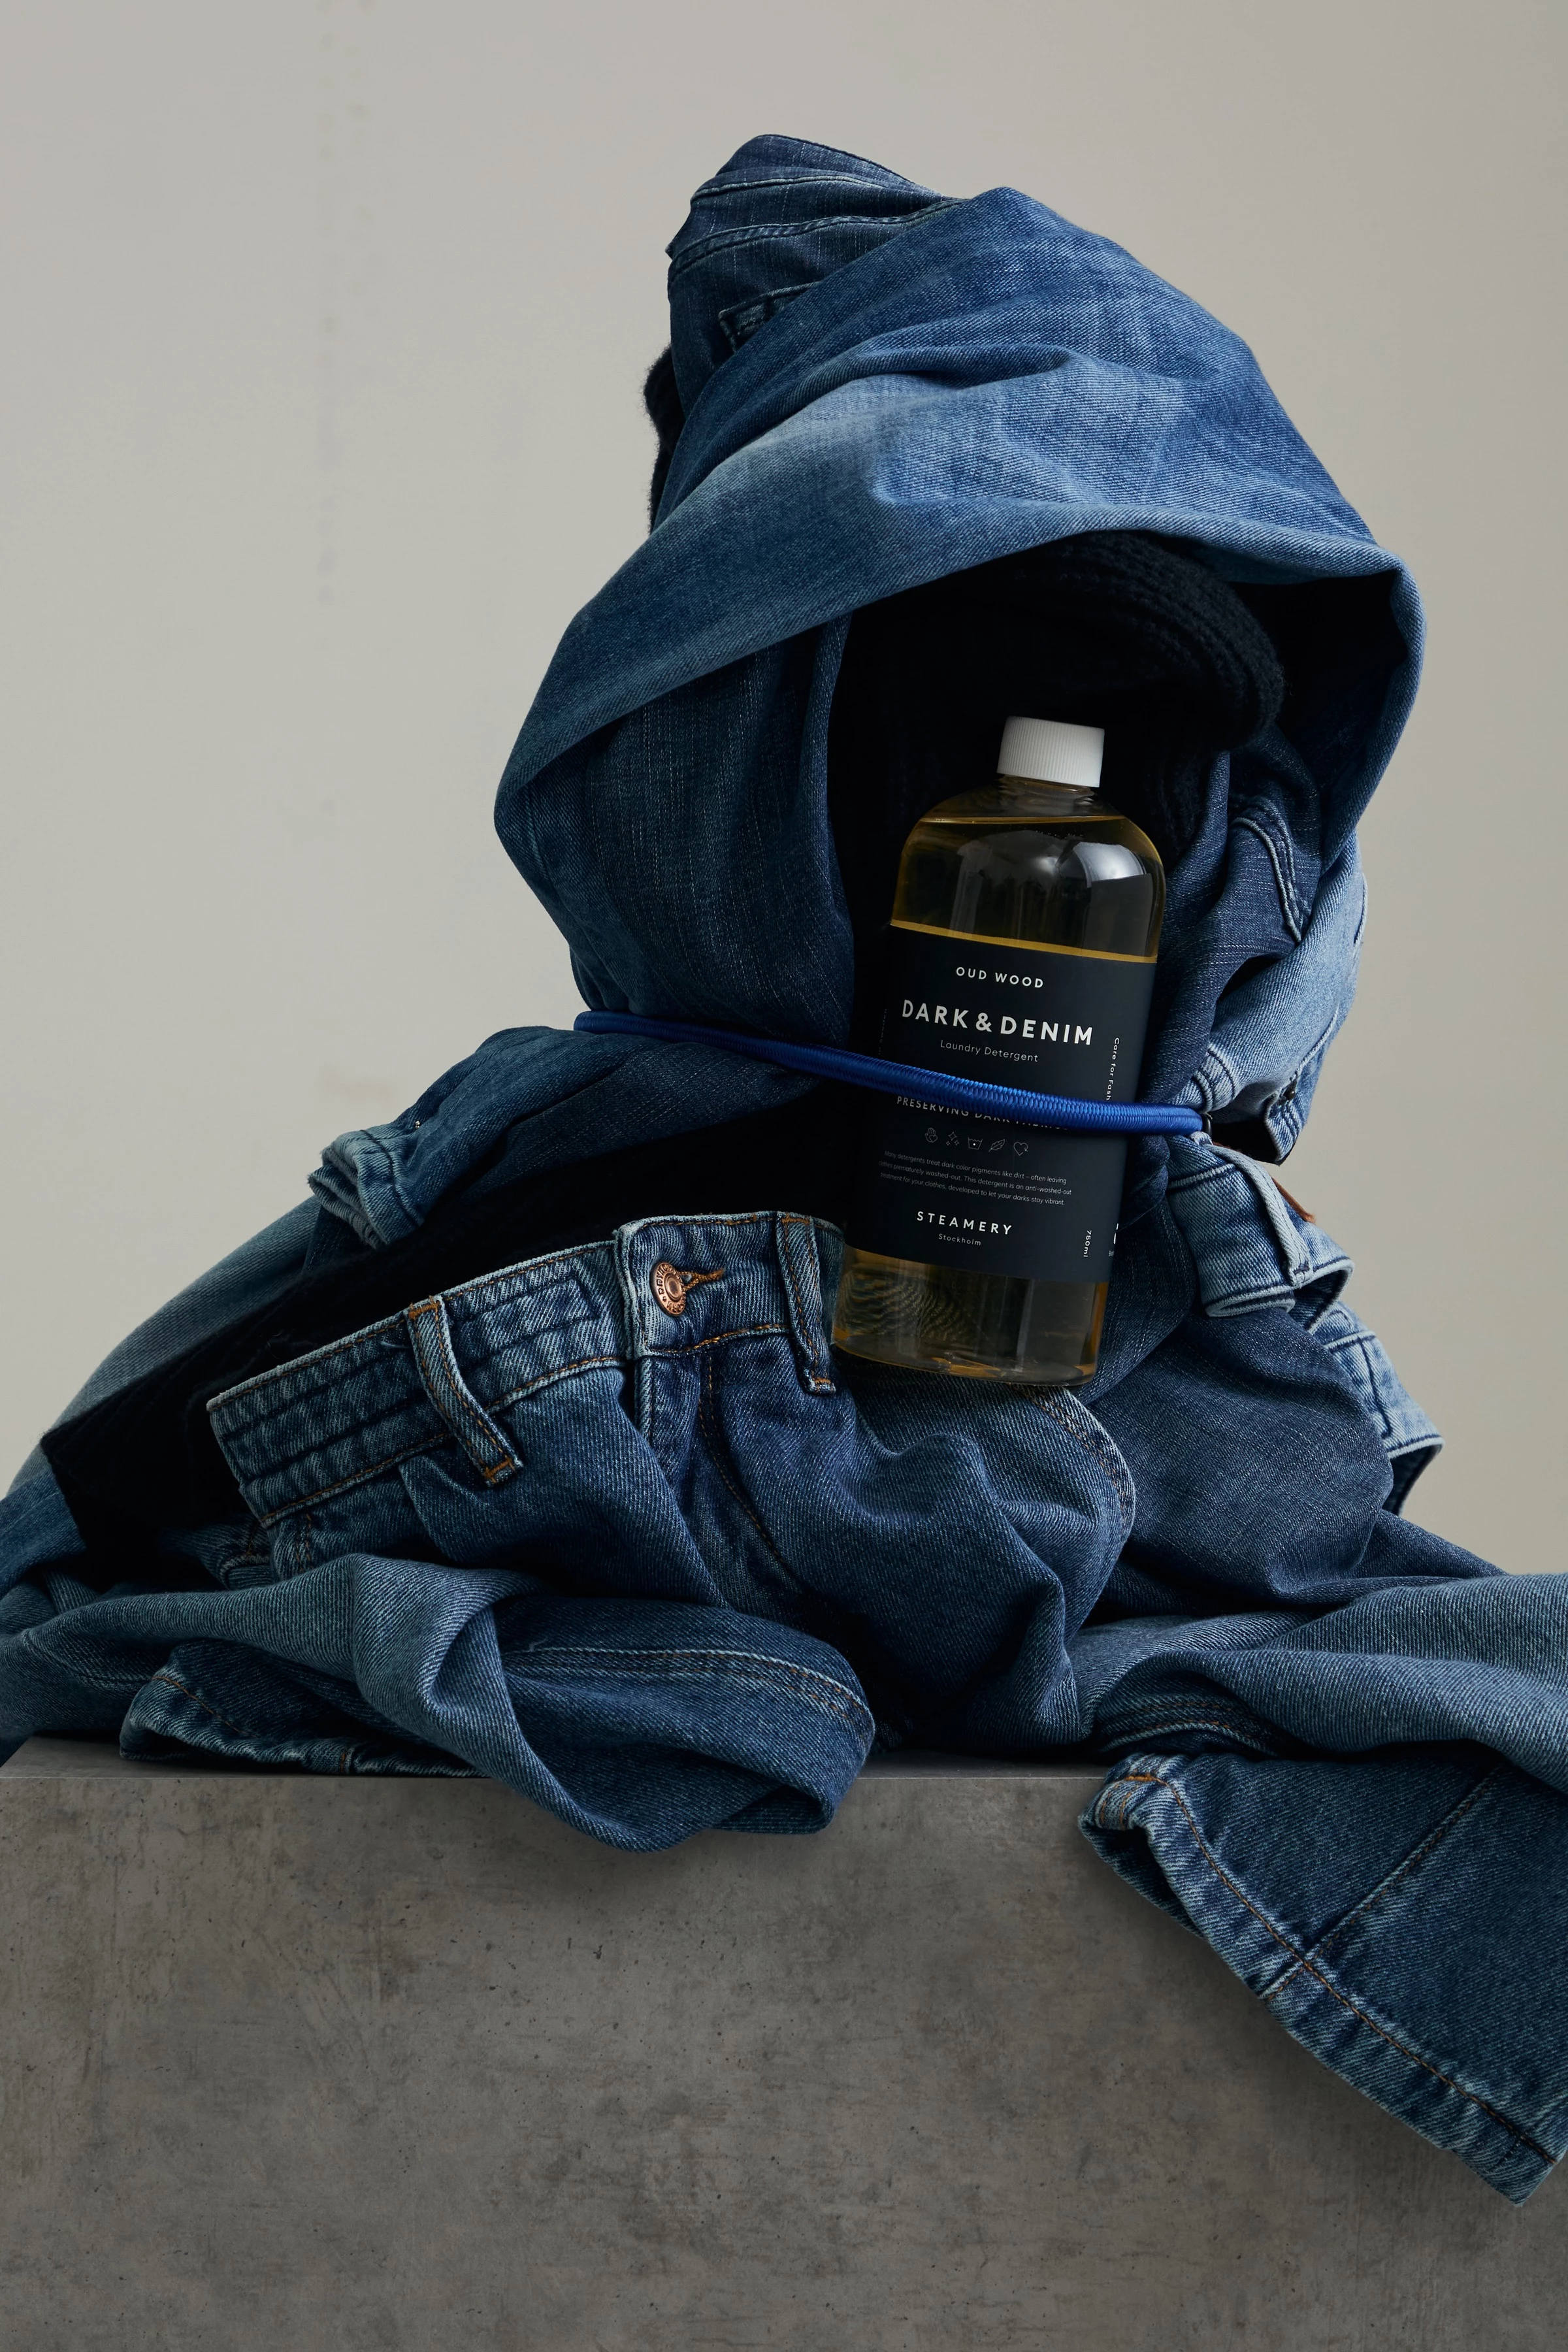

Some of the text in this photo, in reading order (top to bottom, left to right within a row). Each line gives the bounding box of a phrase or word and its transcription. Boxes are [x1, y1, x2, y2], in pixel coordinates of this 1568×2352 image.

[956, 967, 1043, 988] OUD WOOD
[902, 1000, 1093, 1045] DARK & DENIM
[940, 1039, 1039, 1062] Laundry Detergent
[885, 1150, 896, 1159] Many
[897, 1154, 925, 1164] detergents
[972, 1167, 1001, 1175] pigments
[1047, 1176, 1067, 1185] leaving
[893, 1164, 924, 1175] prematurely
[964, 1175, 977, 1184] This
[977, 1178, 1008, 1188] detergent
[1025, 1185, 1072, 1195] anti-washed-out
[880, 1172, 902, 1181] treatment
[924, 1181, 947, 1190] clothes,
[948, 1184, 979, 1194] developed
[917, 1211, 1012, 1235] STEAMERY
[938, 1233, 981, 1246] Stockholm
[1083, 1230, 1092, 1258] 750ml
